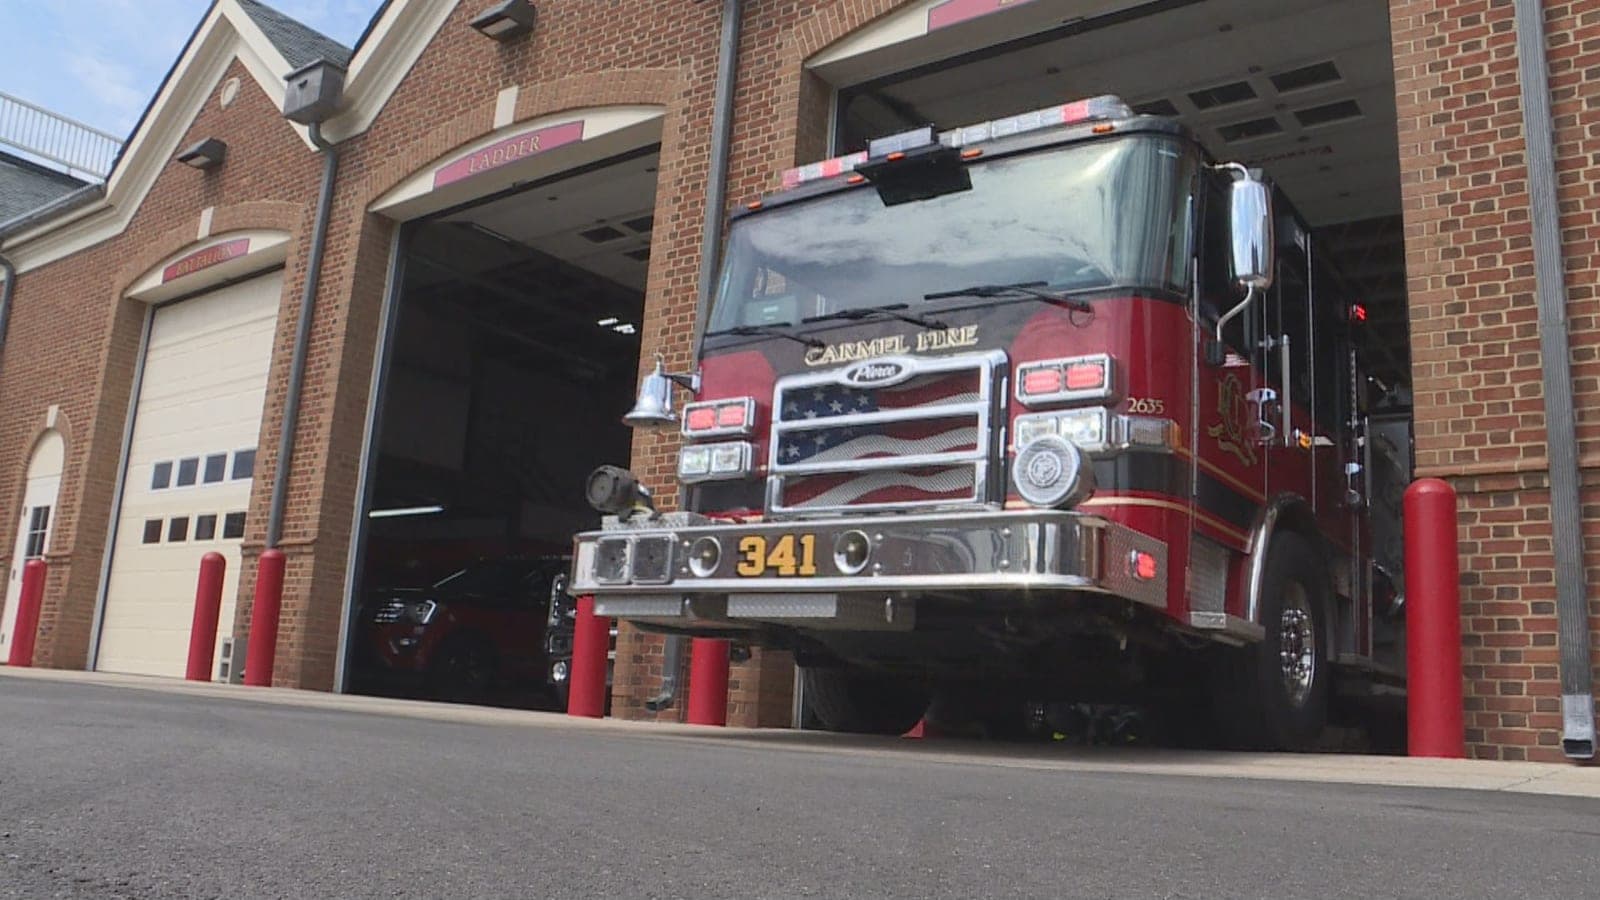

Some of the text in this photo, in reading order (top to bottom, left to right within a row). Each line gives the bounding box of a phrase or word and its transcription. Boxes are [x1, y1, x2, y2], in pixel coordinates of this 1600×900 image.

[467, 135, 541, 174] LADDER
[804, 324, 979, 367] CARMEL FIRE
[852, 364, 897, 383] Pierce
[1127, 397, 1165, 415] 2635
[736, 533, 817, 577] 341
